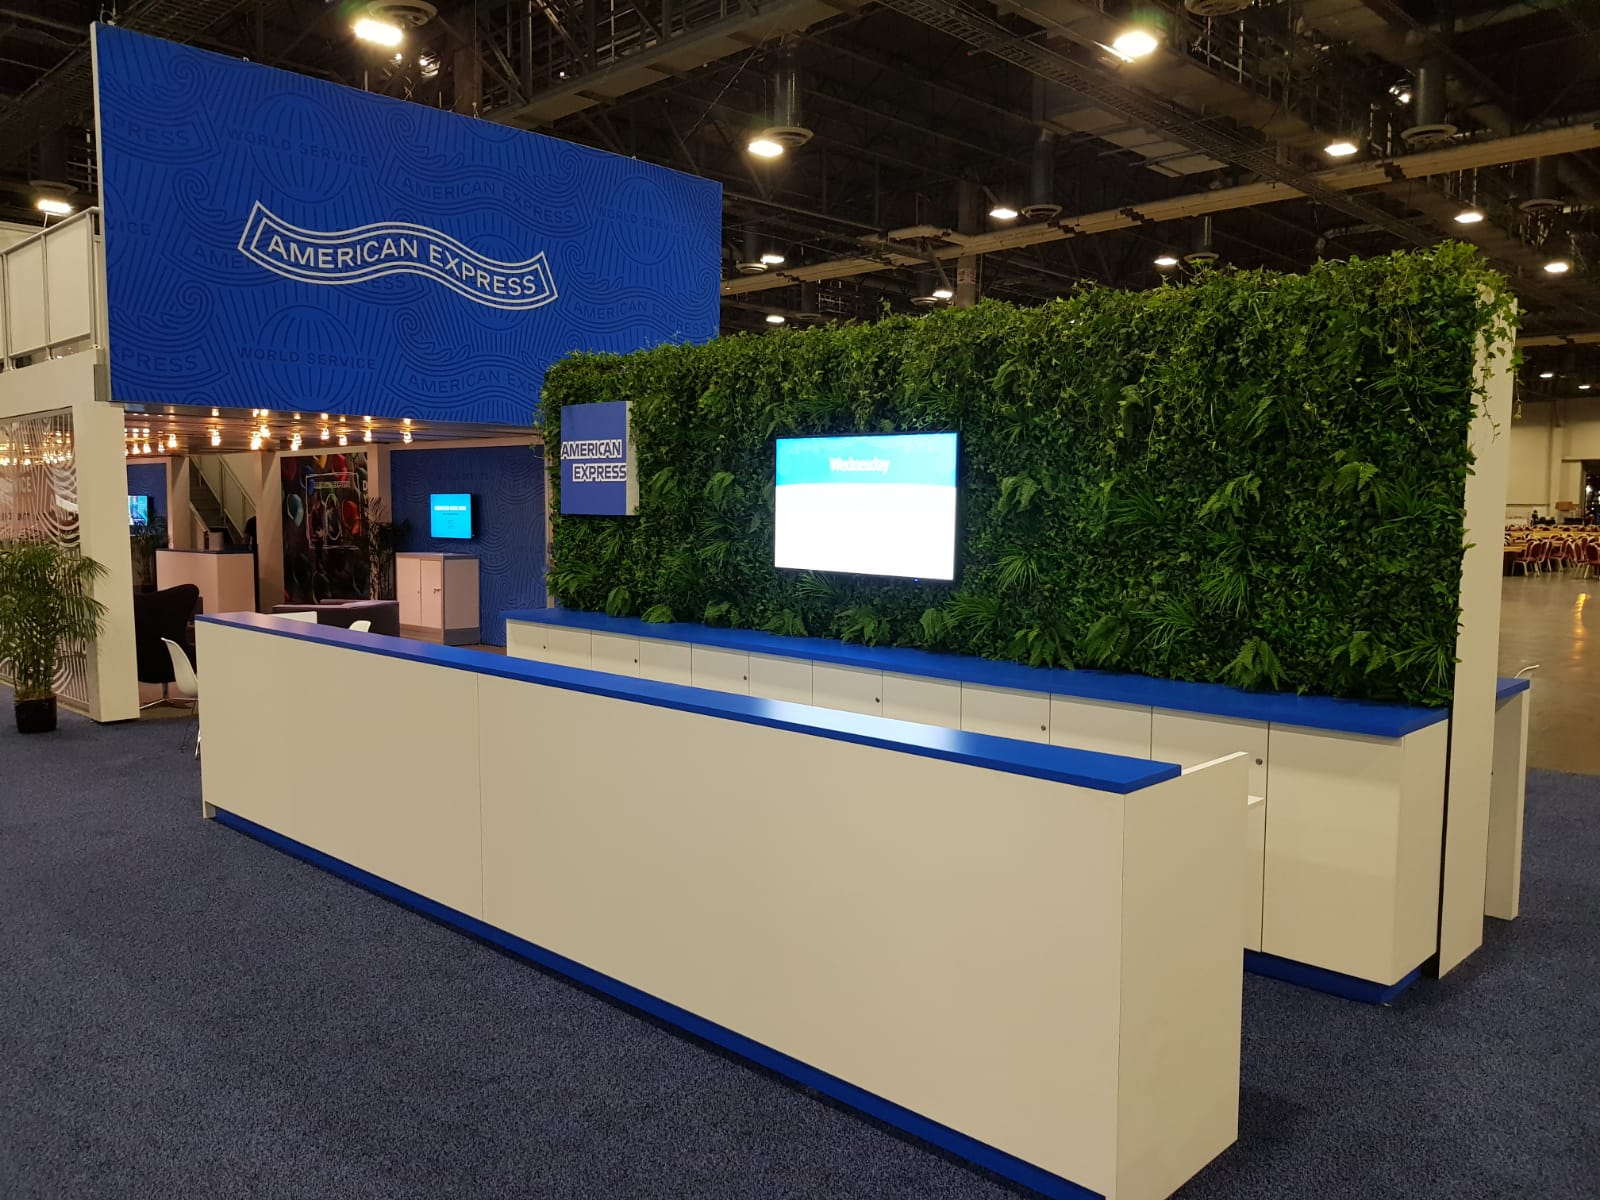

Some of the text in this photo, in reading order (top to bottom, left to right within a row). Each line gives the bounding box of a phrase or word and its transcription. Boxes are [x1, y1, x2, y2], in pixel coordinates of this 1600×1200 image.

[226, 127, 369, 168] WORLD SERVICE
[402, 176, 573, 224] AMERICAN EXPRESS
[598, 204, 689, 236] WORLD SERVICE
[268, 234, 536, 296] AMERICAN EXPRESS
[575, 301, 707, 334] AMERICAN EXPRESS
[236, 346, 376, 370] WORLD SERVICE
[408, 370, 500, 393] AMERICAN
[561, 441, 621, 458] AMERICAN
[573, 464, 627, 481] EXPRESS
[829, 456, 891, 475] Wednesday
